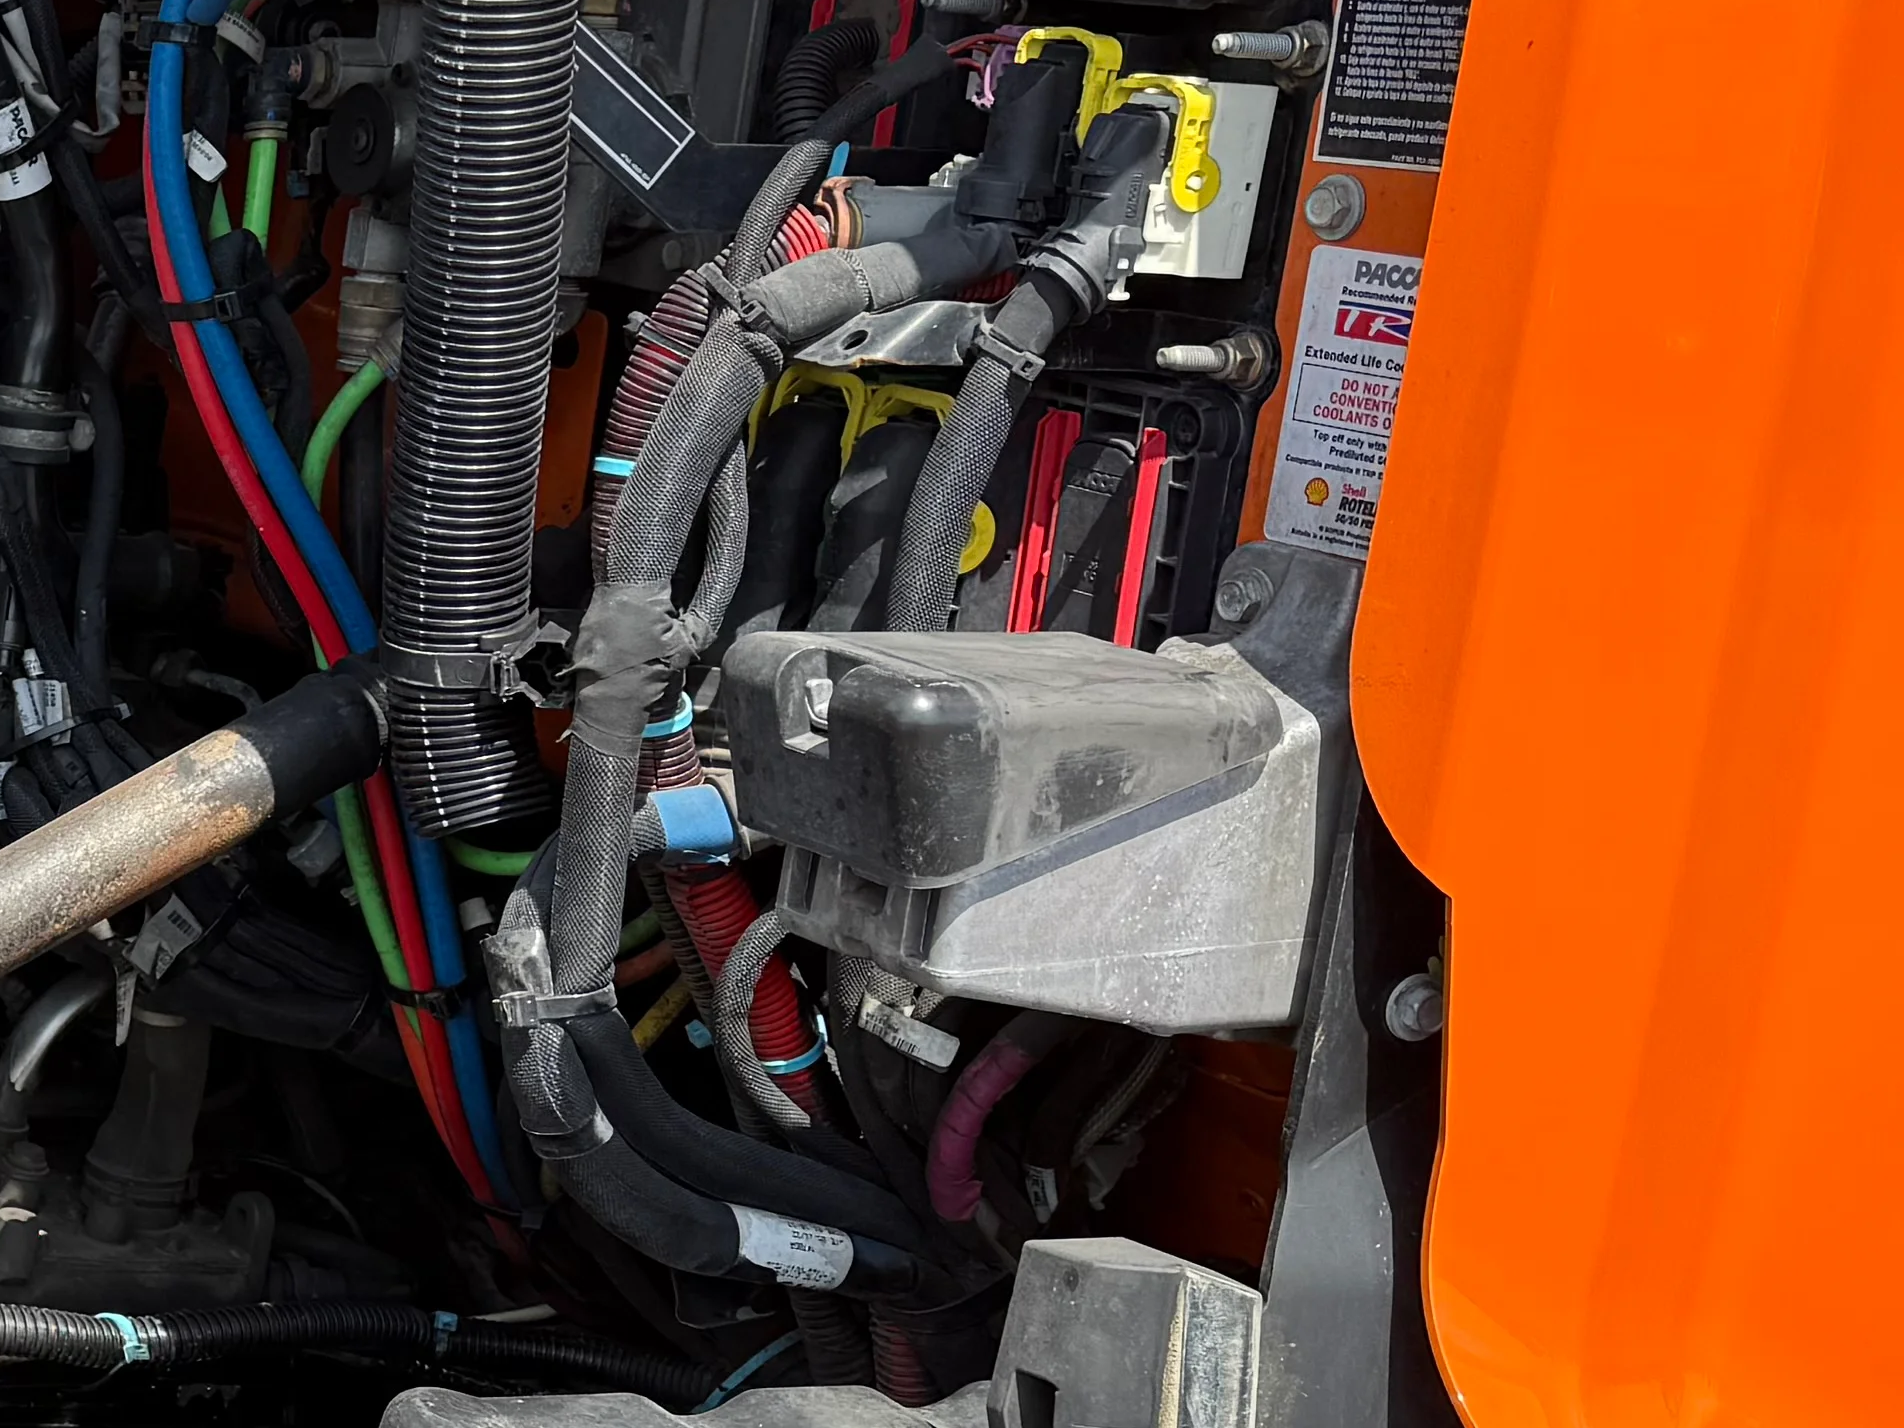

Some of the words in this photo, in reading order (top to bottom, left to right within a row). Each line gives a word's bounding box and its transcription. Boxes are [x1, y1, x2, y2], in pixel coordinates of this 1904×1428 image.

[1355, 260, 1420, 290] PACC
[1342, 287, 1405, 305] Recommended
[1305, 346, 1357, 366] Extended
[1361, 355, 1382, 369] Life
[1342, 378, 1360, 392] DO
[1363, 381, 1389, 396] NOT
[1330, 393, 1397, 414] CONVENTI
[1313, 405, 1378, 429] COOLANTS
[1314, 430, 1329, 443] Top
[1331, 433, 1344, 444] off
[1347, 435, 1365, 450] only
[1329, 446, 1375, 464] Prediluted
[1342, 483, 1366, 498] Shell
[1339, 496, 1377, 518] ROTEL
